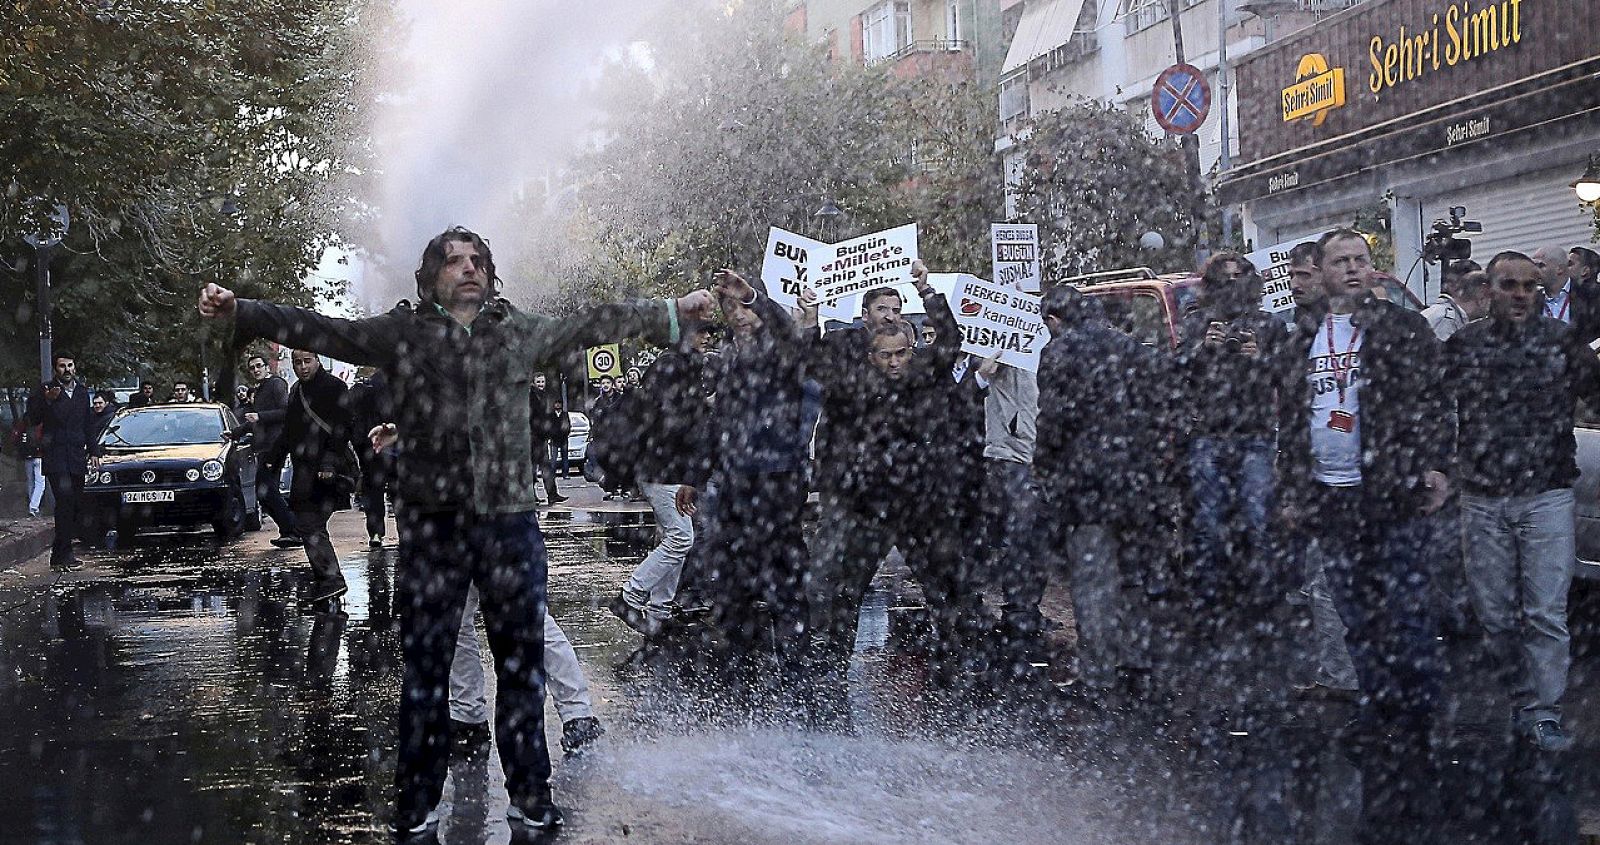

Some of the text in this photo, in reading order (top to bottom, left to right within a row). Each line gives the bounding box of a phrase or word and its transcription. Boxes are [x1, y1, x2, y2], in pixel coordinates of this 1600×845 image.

[1370, 0, 1522, 103] Şehr-i Simit
[1284, 77, 1333, 118] Şehr-i Simit
[835, 246, 903, 271] Millet'e
[836, 237, 887, 258] Bugün
[1003, 244, 1034, 260] BUGÜN
[815, 257, 911, 288] sahip çıkma
[999, 260, 1034, 286] SUSMAZ
[963, 283, 1042, 315] HERKES SUSS
[958, 323, 1036, 354] SUSMAZ
[597, 356, 610, 366] 30
[127, 493, 137, 501] 34
[161, 491, 173, 500] 74
